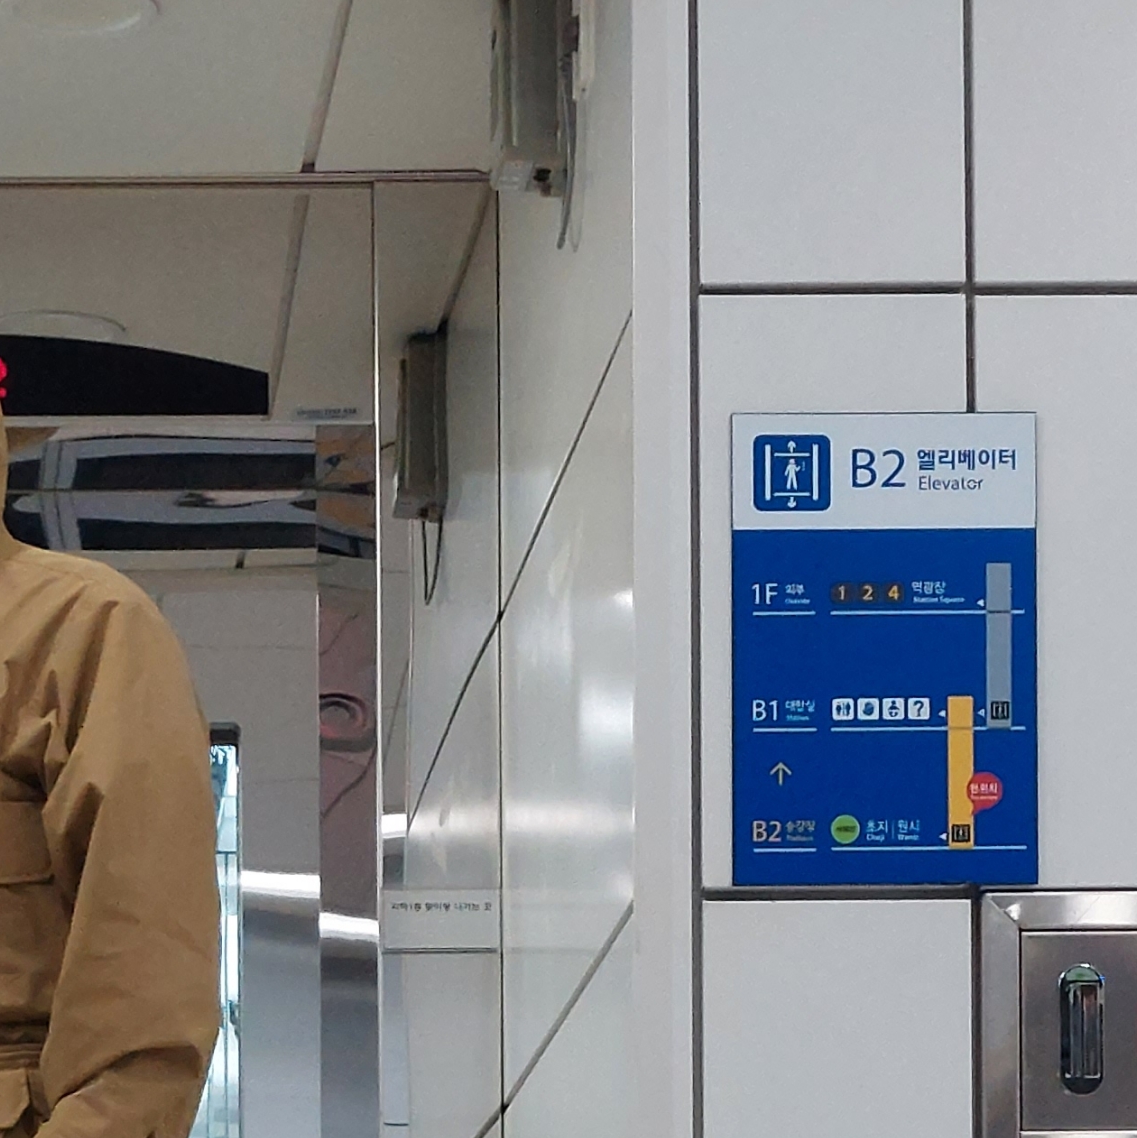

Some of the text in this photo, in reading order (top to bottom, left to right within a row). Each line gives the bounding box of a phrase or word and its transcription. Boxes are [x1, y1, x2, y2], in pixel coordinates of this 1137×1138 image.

[851, 448, 1016, 488] B2 엘리베이터
[918, 475, 983, 491] Elevator
[752, 583, 778, 605] 1F
[838, 585, 846, 600] 1
[862, 585, 873, 600] 2
[888, 585, 900, 600] 4
[752, 700, 778, 721] B1
[752, 820, 782, 842] B2
